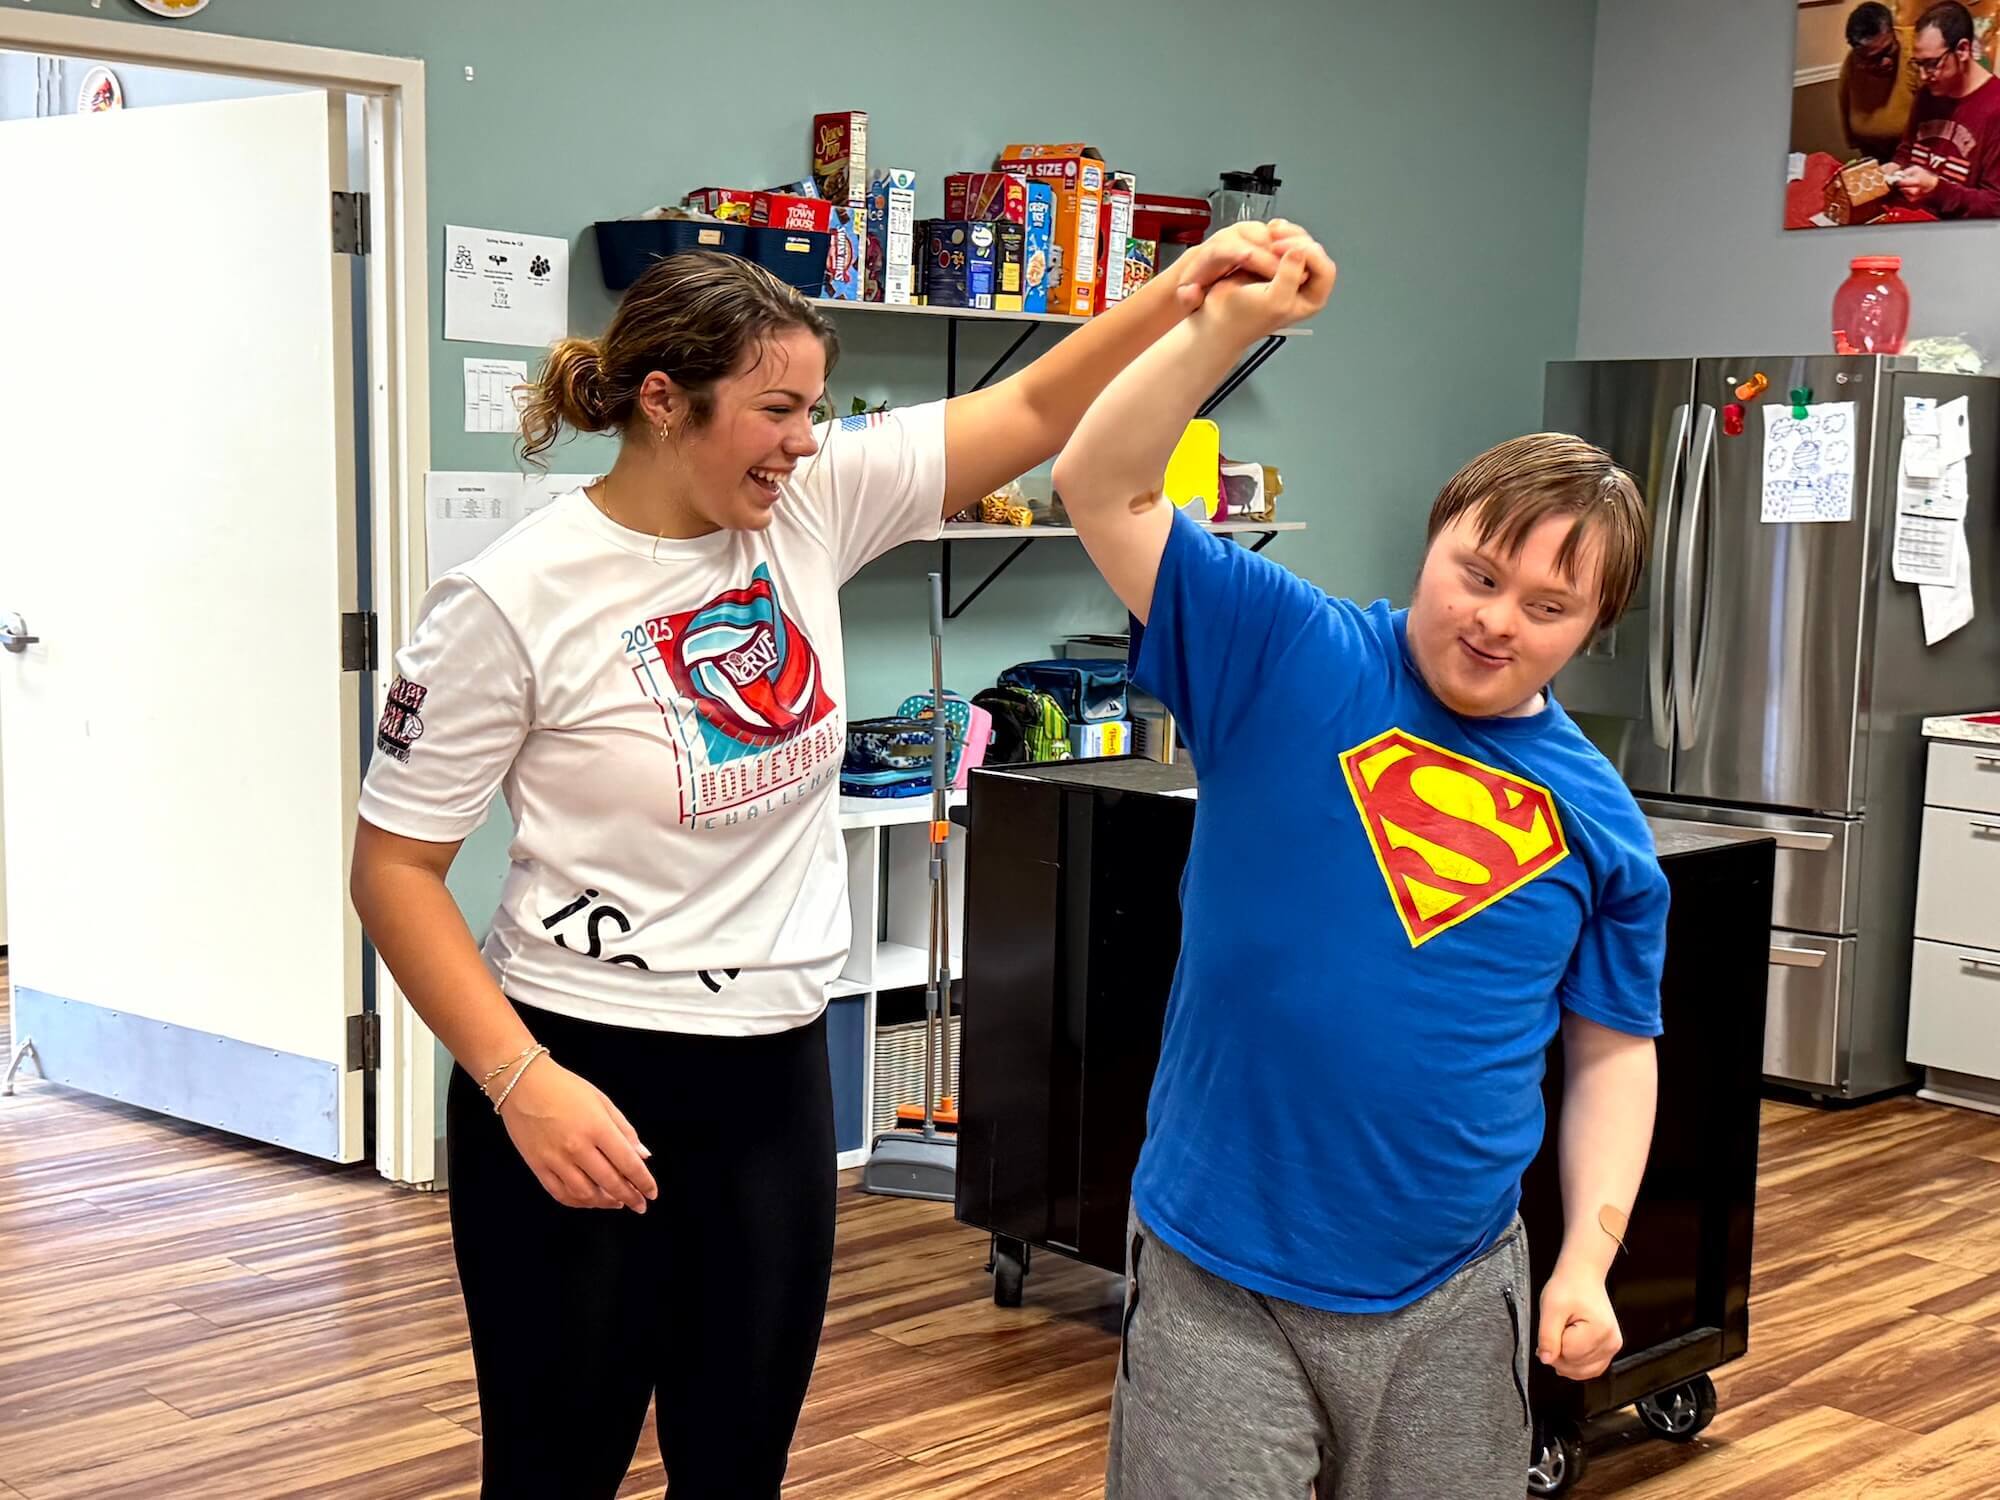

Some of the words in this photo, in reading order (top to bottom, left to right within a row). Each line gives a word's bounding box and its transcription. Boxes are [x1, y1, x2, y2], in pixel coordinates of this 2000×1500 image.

[1035, 162, 1063, 177] SIZE
[787, 206, 815, 220] TOWN
[785, 217, 815, 231] HOUSE
[621, 618, 674, 654] 2025
